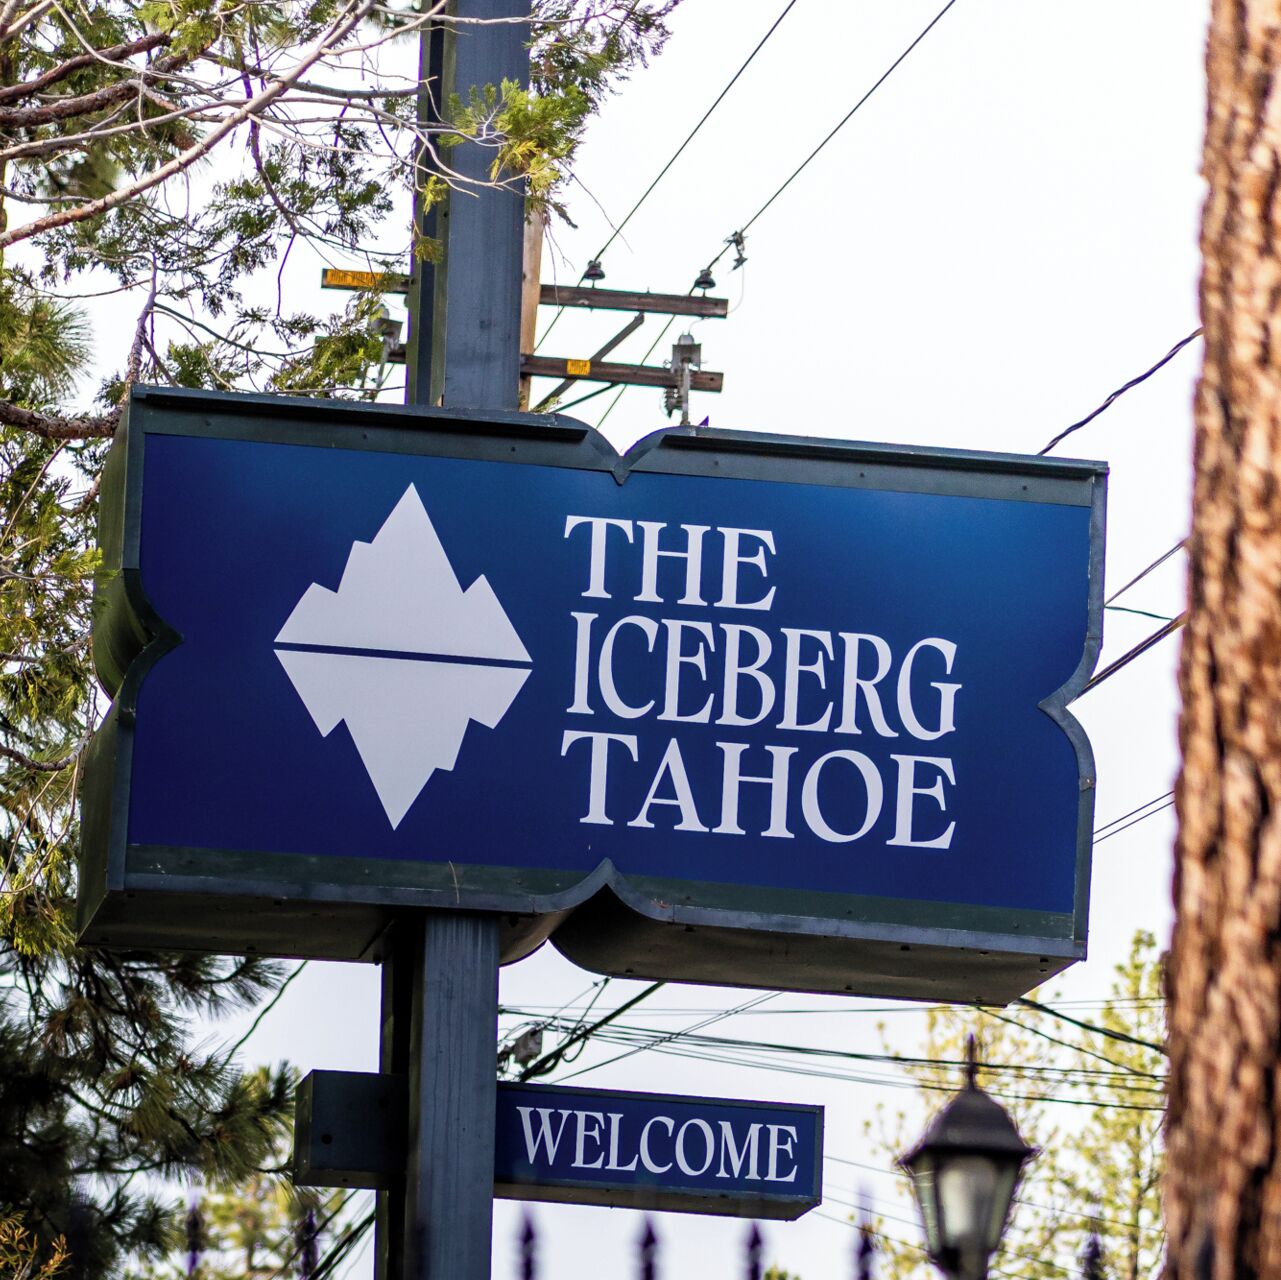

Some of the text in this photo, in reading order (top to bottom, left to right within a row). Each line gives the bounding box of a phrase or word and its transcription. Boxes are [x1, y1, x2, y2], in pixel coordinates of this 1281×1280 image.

[564, 515, 777, 611] THE
[566, 611, 963, 741] ICEBERG
[561, 730, 957, 850] TAHOE
[516, 1107, 798, 1183] WELCOME
